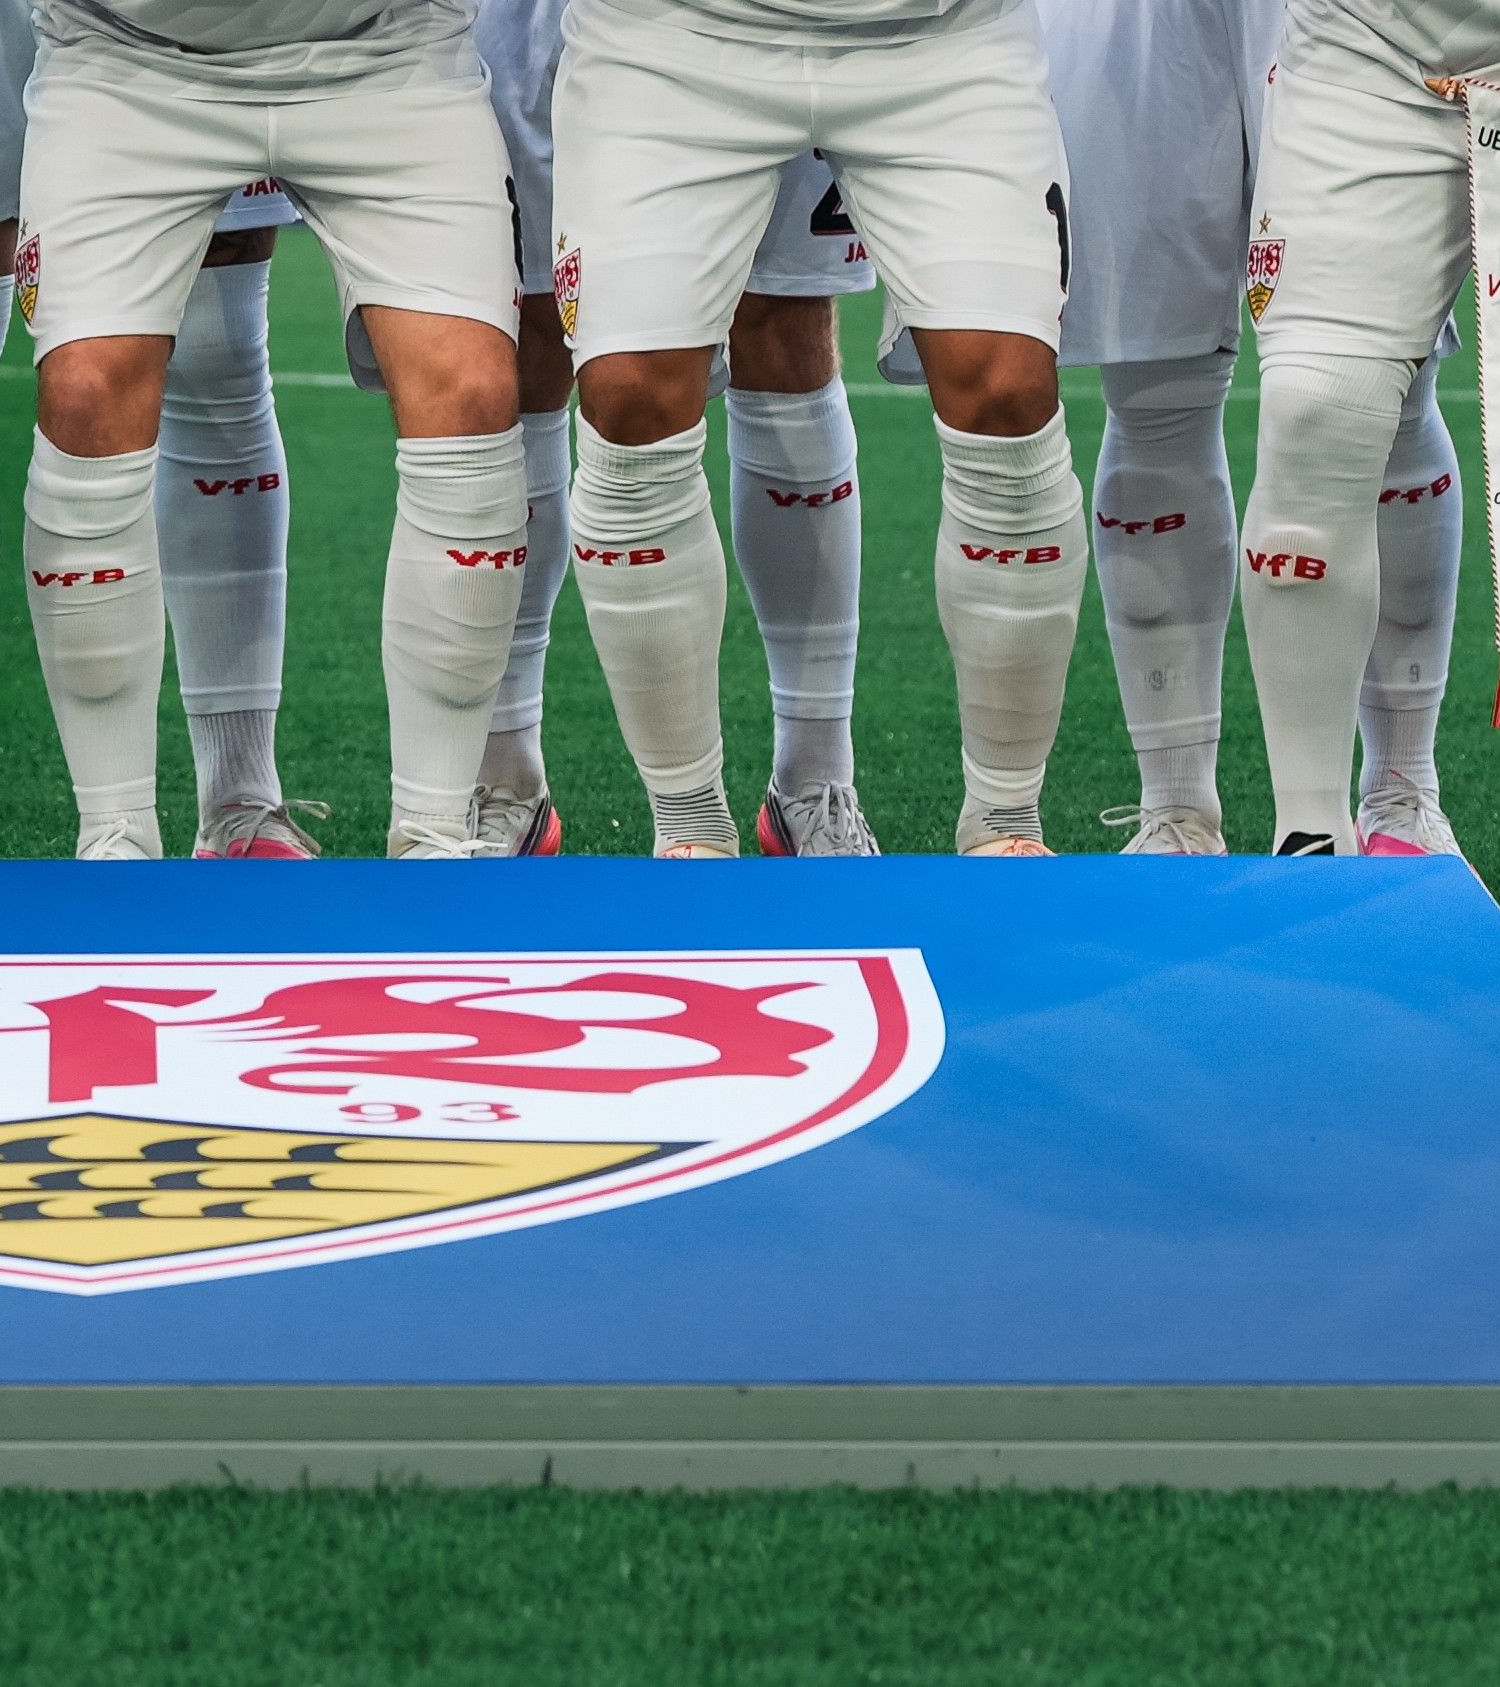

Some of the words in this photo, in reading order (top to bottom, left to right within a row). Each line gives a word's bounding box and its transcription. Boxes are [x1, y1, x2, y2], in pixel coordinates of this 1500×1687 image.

[193, 472, 280, 497] VfB
[766, 480, 854, 509] VfB
[1096, 511, 1187, 535] VfB
[446, 545, 528, 570] VfB
[574, 543, 666, 565] VfB
[960, 543, 1062, 565] VfB
[1247, 548, 1327, 581] VfB
[31, 568, 125, 587] VfB
[337, 1101, 522, 1125] 93
